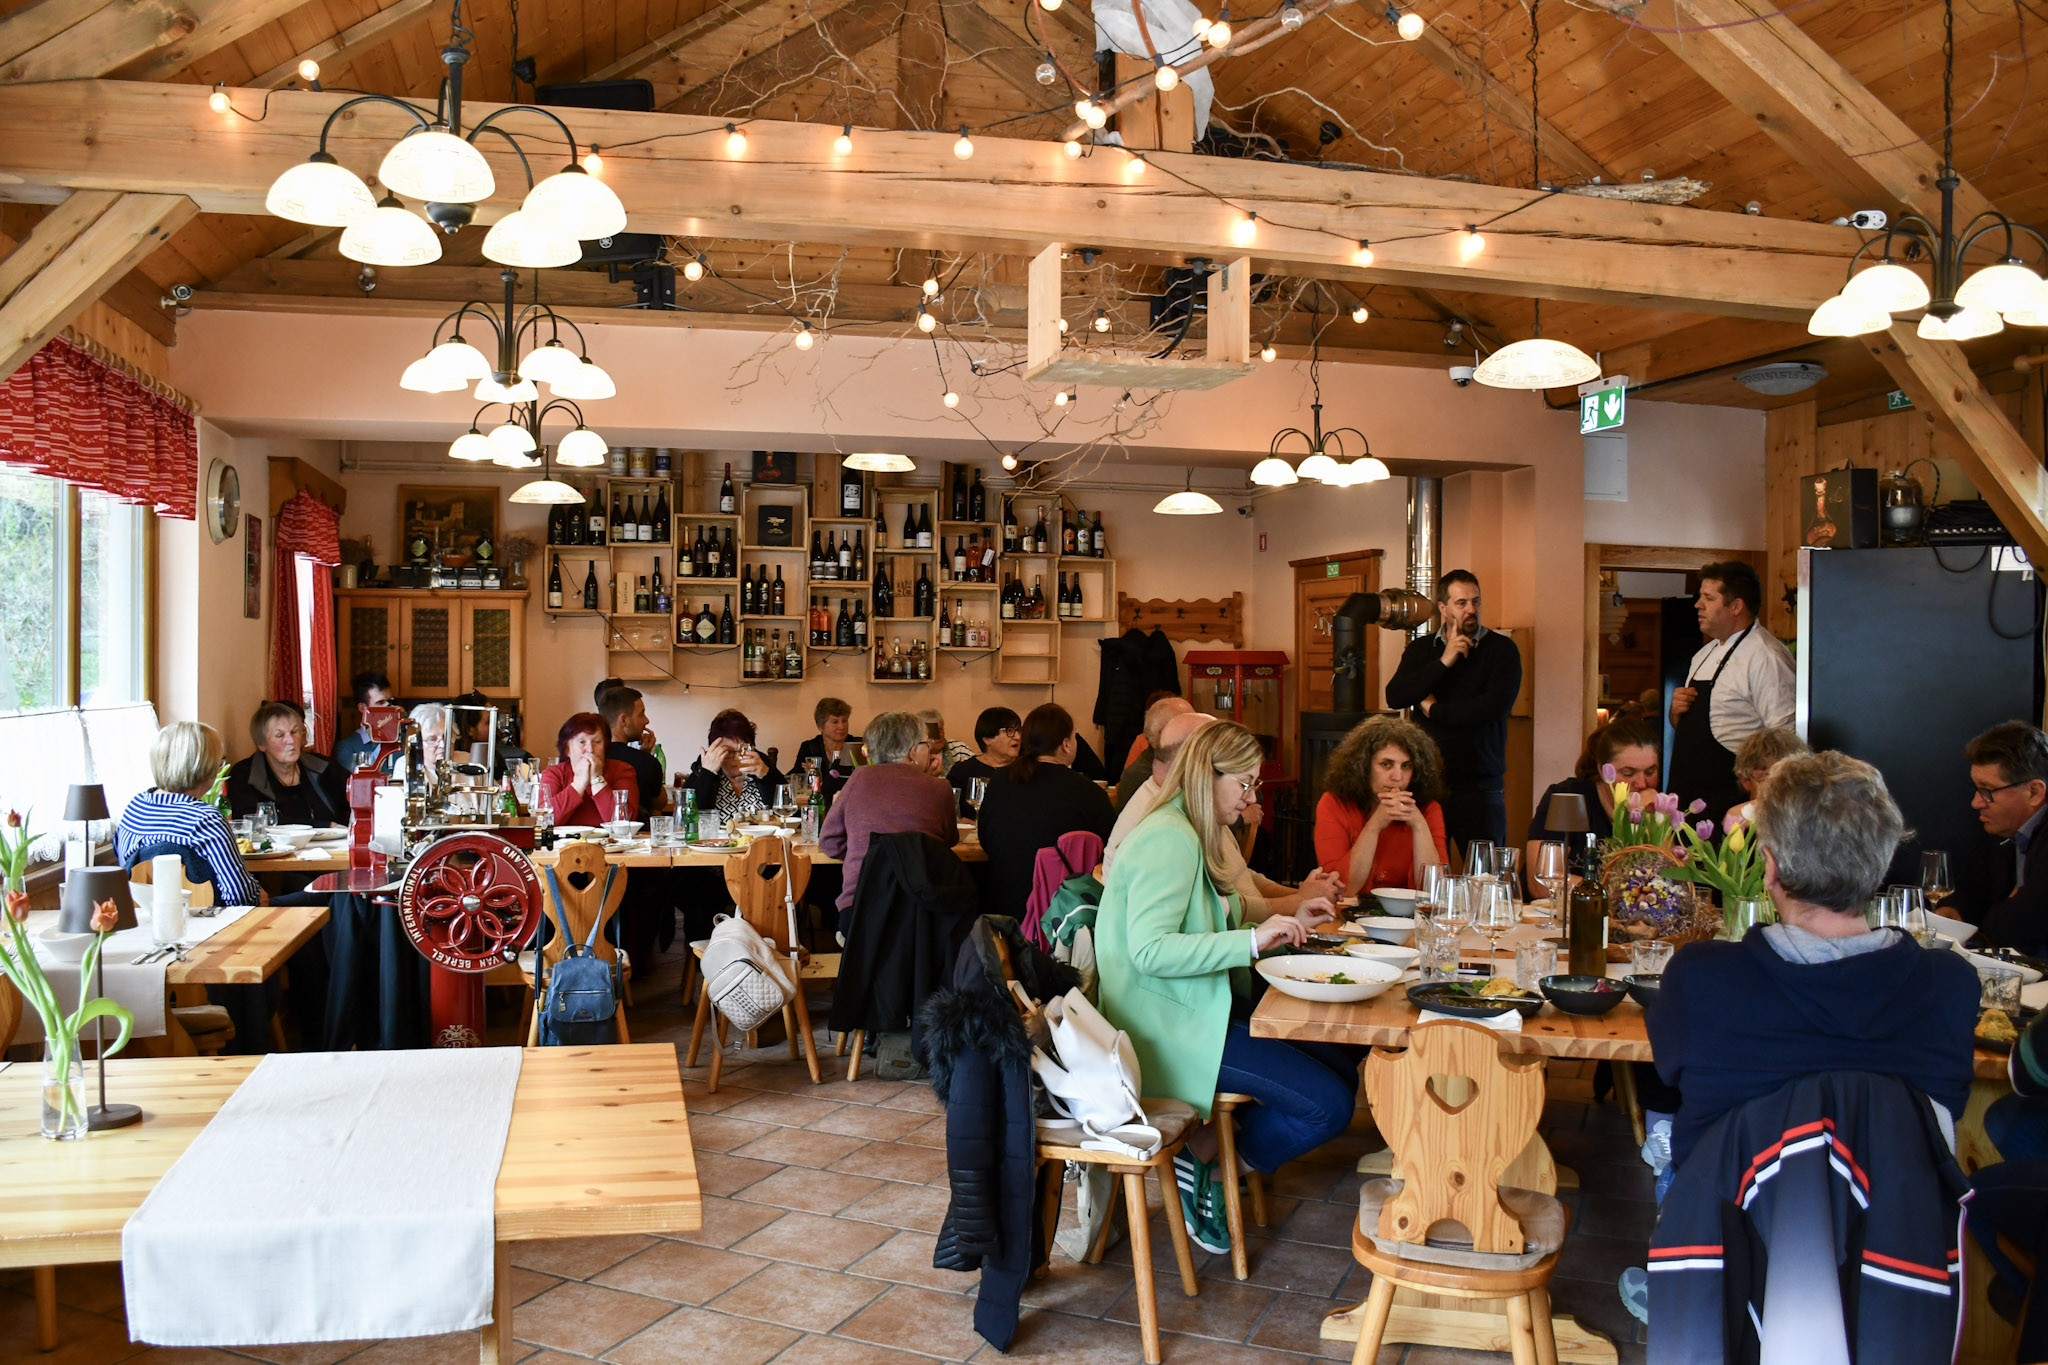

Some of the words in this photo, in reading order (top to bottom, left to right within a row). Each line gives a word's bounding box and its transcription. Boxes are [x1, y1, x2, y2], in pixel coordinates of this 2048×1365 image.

[502, 846, 535, 882] MILANO
[402, 867, 424, 943] INTERNATIONAL
[431, 948, 472, 968] BERKEL
[479, 955, 500, 968] VAN
